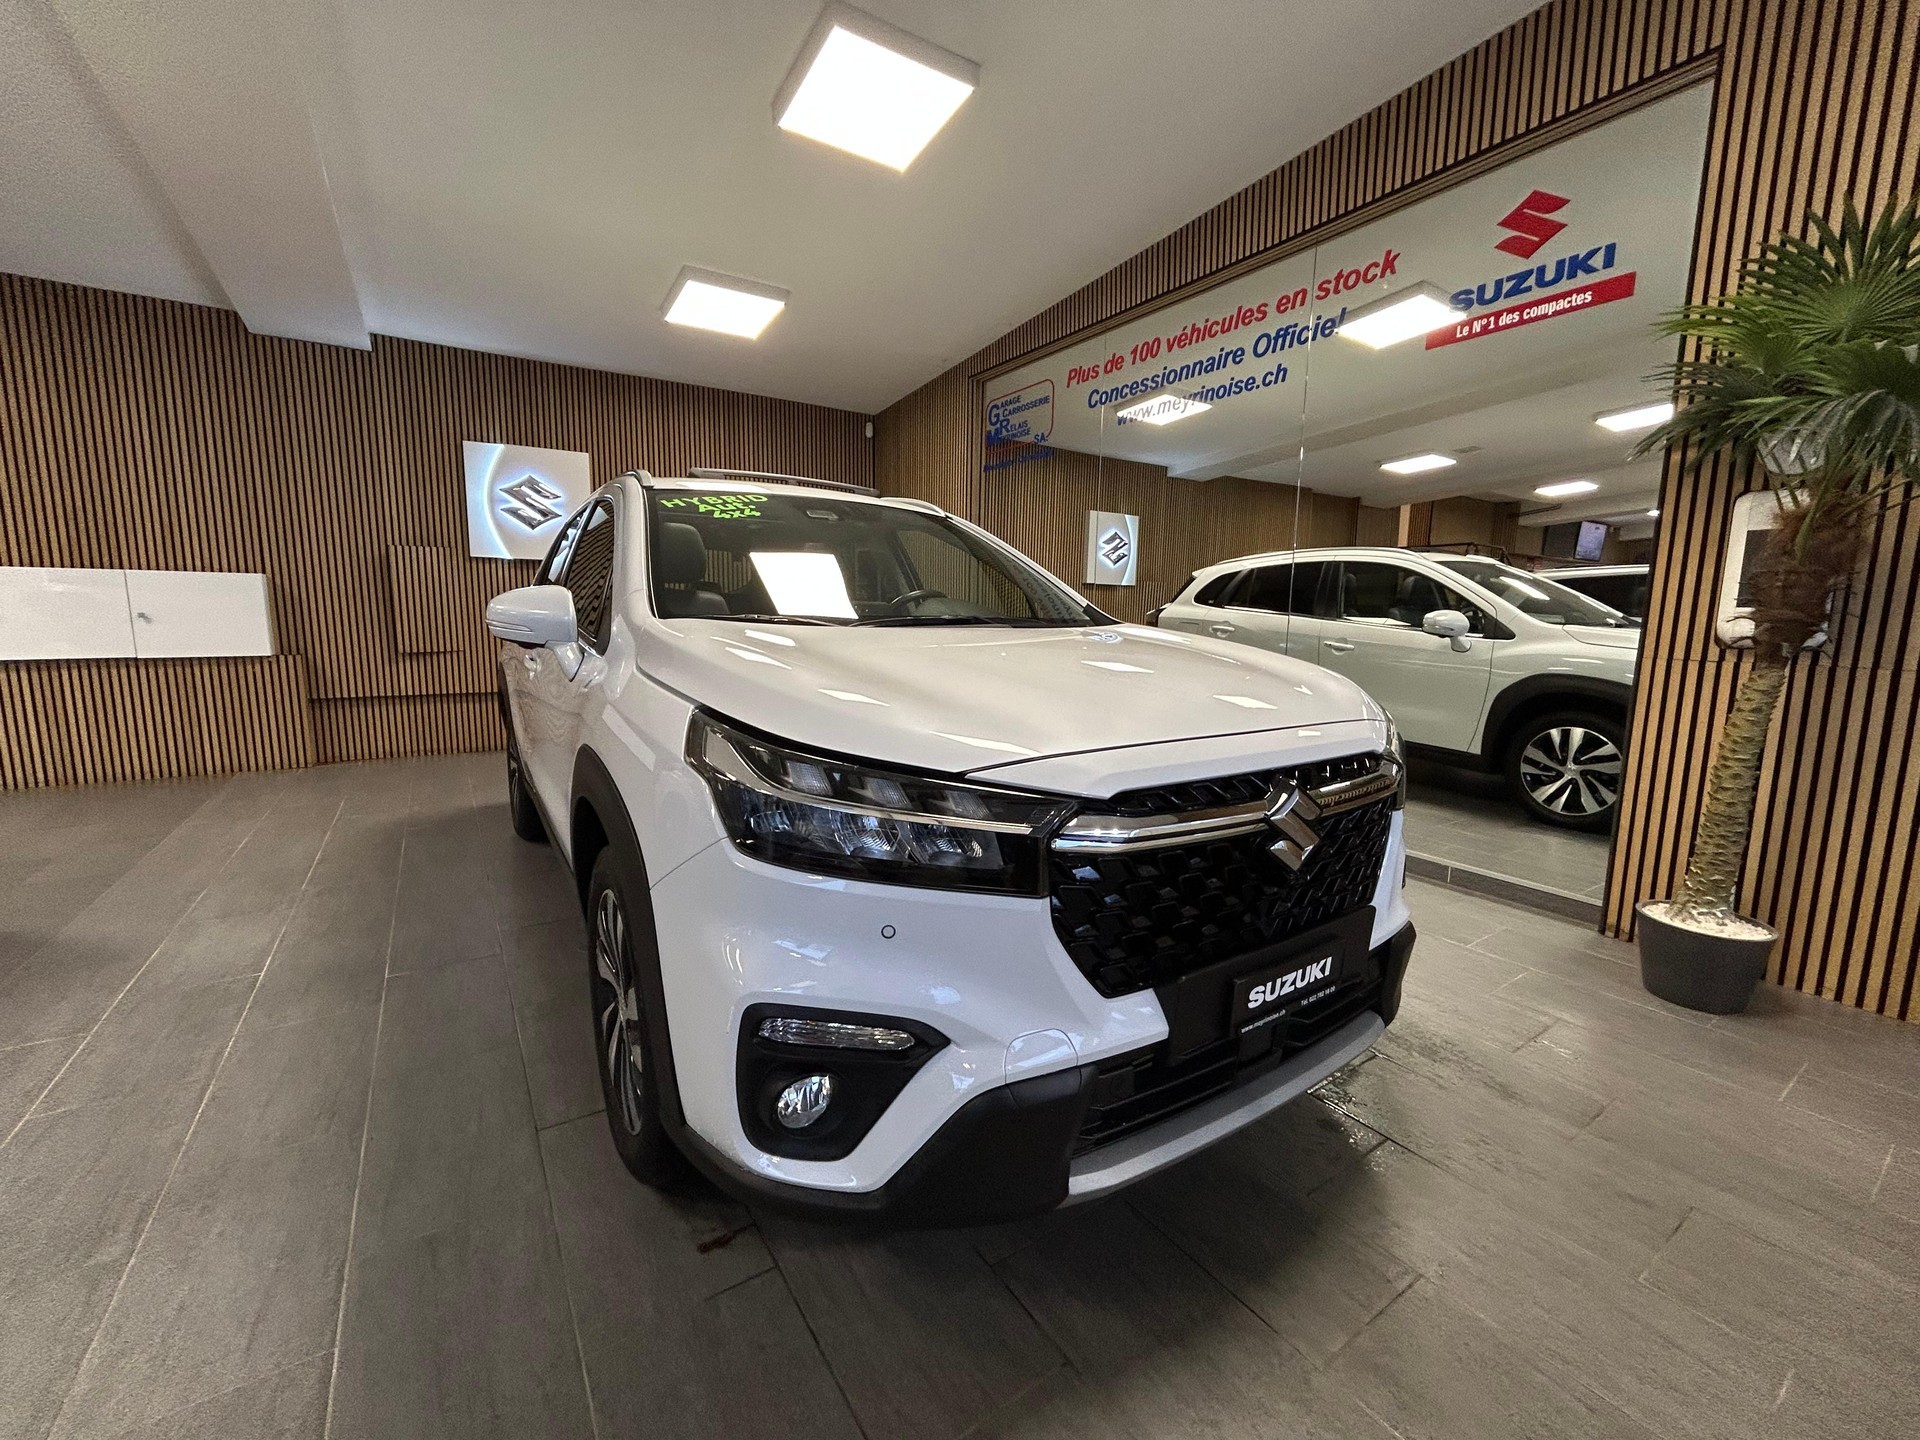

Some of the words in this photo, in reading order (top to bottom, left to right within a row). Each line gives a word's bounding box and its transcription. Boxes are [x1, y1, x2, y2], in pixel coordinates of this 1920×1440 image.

[1450, 242, 1616, 312] SUZUKI
[1066, 365, 1100, 388] Plus
[1103, 352, 1125, 375] de
[1130, 337, 1161, 366] 100
[1166, 303, 1269, 353] véhicules
[1276, 287, 1308, 314] en
[1315, 249, 1400, 301] stock
[1456, 324, 1469, 338] Le
[1498, 311, 1520, 327] des
[1523, 290, 1593, 320] compactes
[1088, 347, 1245, 409] Concessionnaire
[1252, 307, 1347, 358] Officiel
[1117, 363, 1288, 426] www.meyrinoise.ch
[660, 494, 768, 508] HYBRID
[1247, 956, 1332, 1009] SUZUKI
